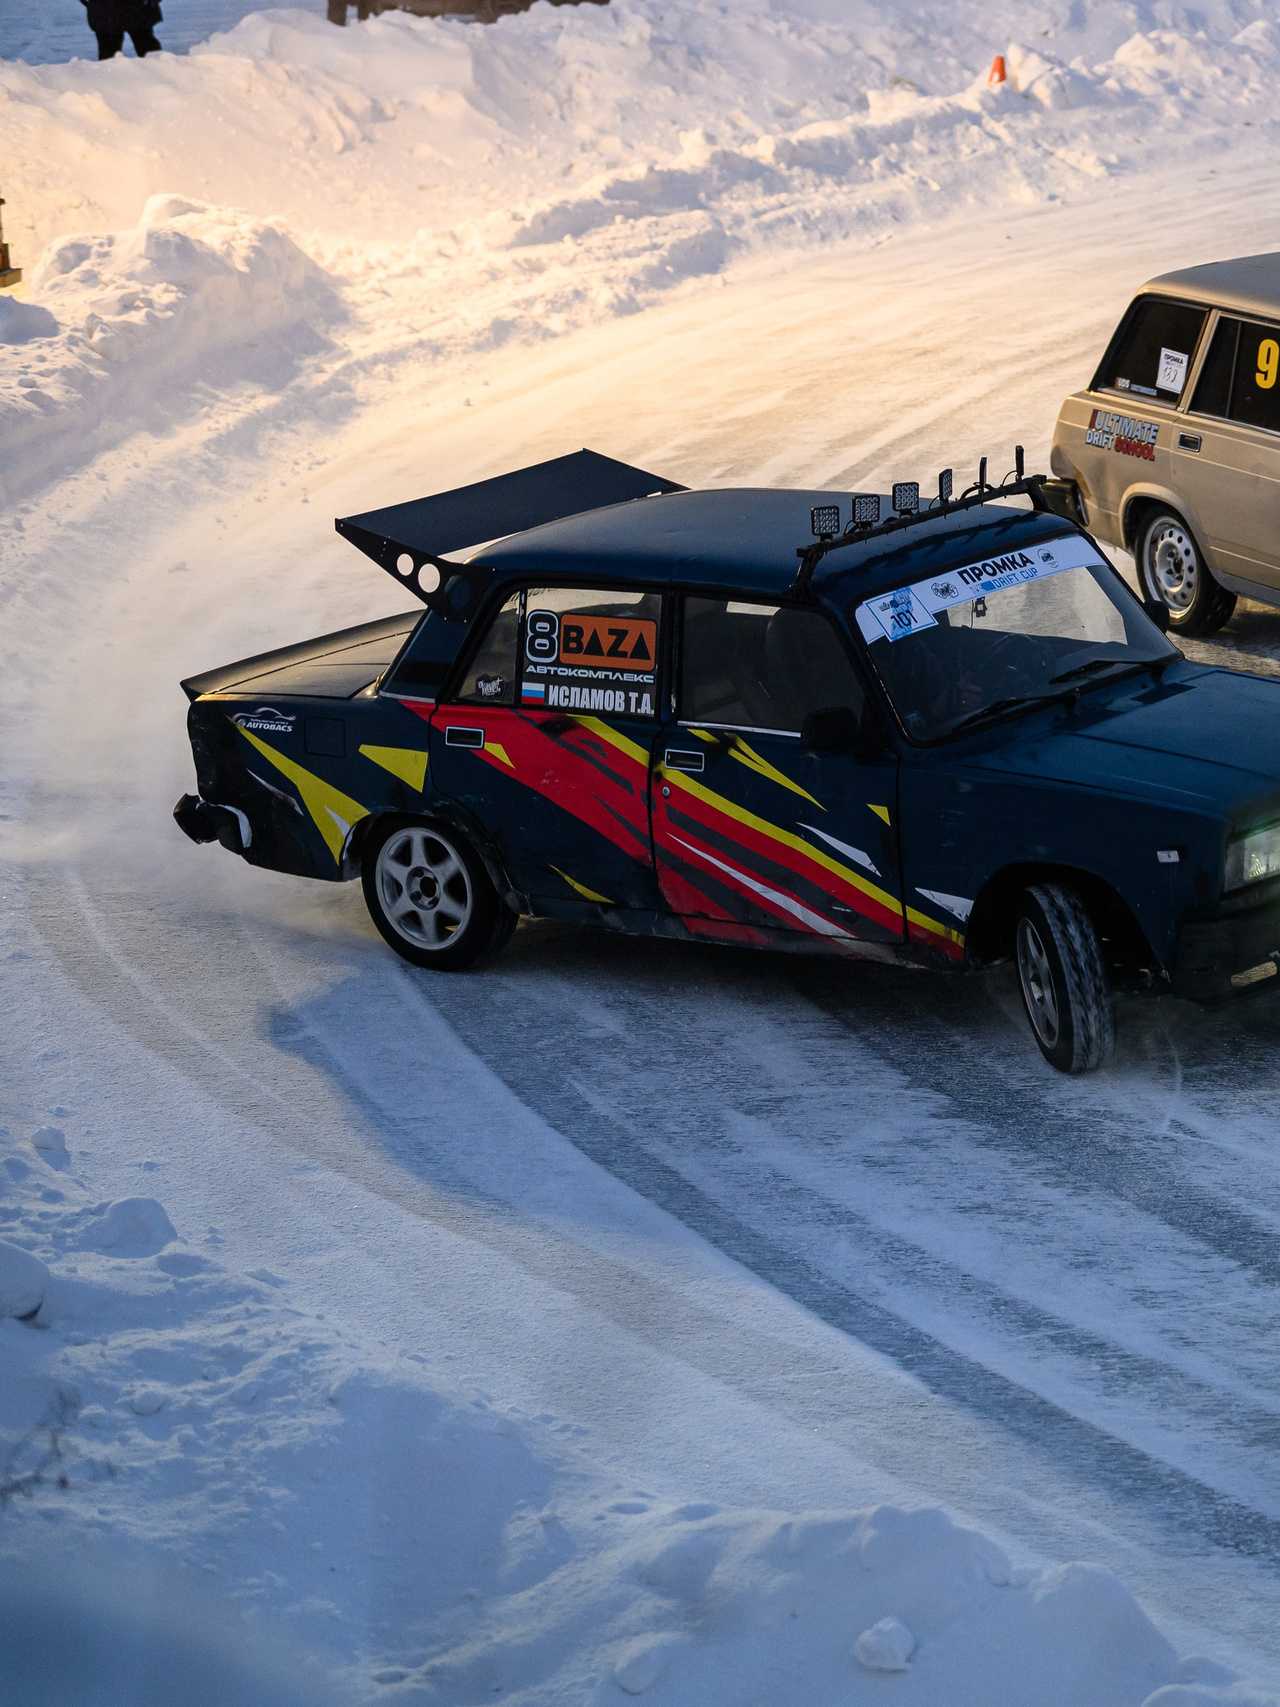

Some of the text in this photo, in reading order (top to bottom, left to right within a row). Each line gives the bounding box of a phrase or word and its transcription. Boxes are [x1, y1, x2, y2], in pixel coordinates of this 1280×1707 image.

[1093, 409, 1160, 445] ULTIMATE
[1085, 429, 1156, 462] DRIFT SCHOOL
[957, 552, 1035, 585] ПРОМКА
[993, 567, 1038, 588] DRIFT CUP
[890, 609, 918, 629] 101
[563, 624, 651, 660] BAZA
[526, 665, 654, 683] АВТОКОМПЛЕКС
[548, 684, 655, 715] ИСЛАМОВ Т.А.
[246, 721, 293, 732] AUTOBACS
